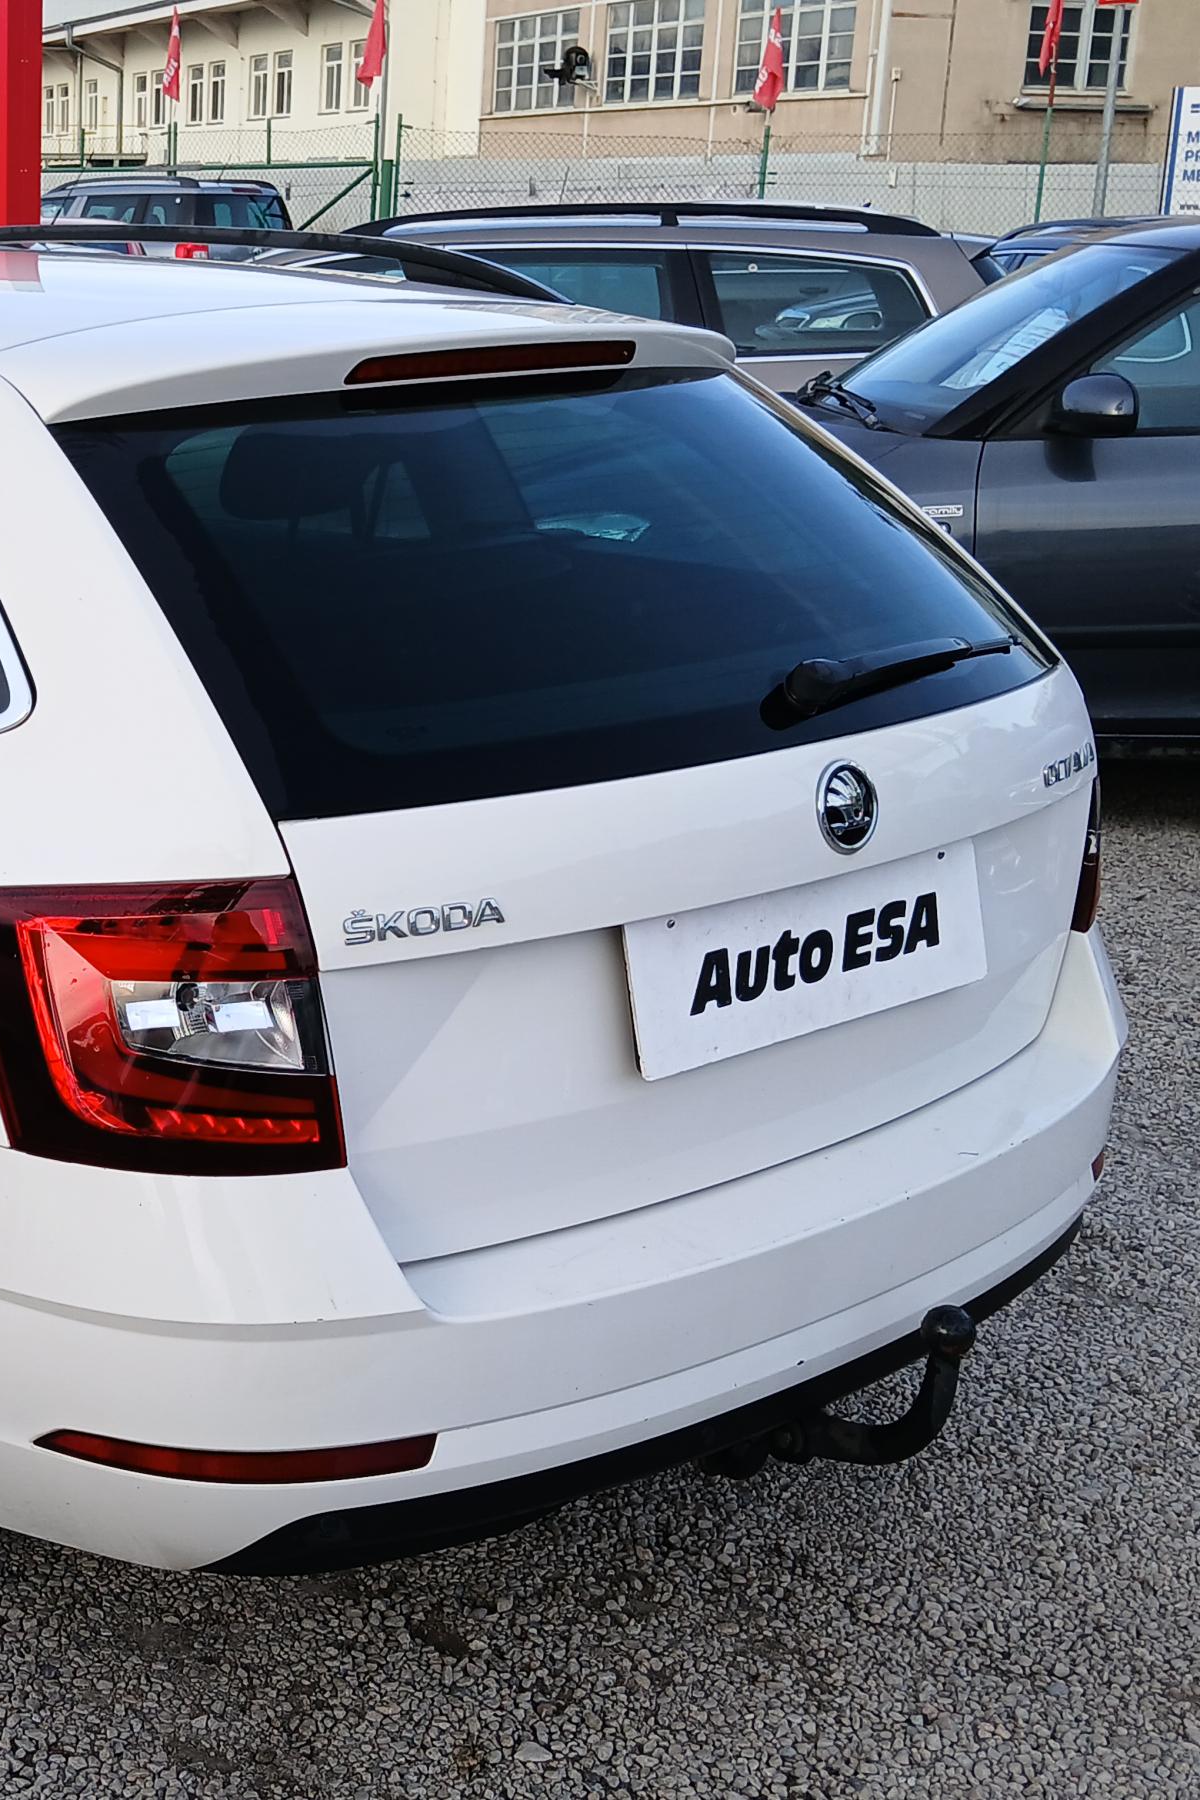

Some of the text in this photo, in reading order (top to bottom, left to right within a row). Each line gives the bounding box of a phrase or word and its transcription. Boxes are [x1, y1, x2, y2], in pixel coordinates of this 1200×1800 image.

[343, 897, 505, 946] ŠKODA
[689, 891, 940, 1016] Auto ESA
